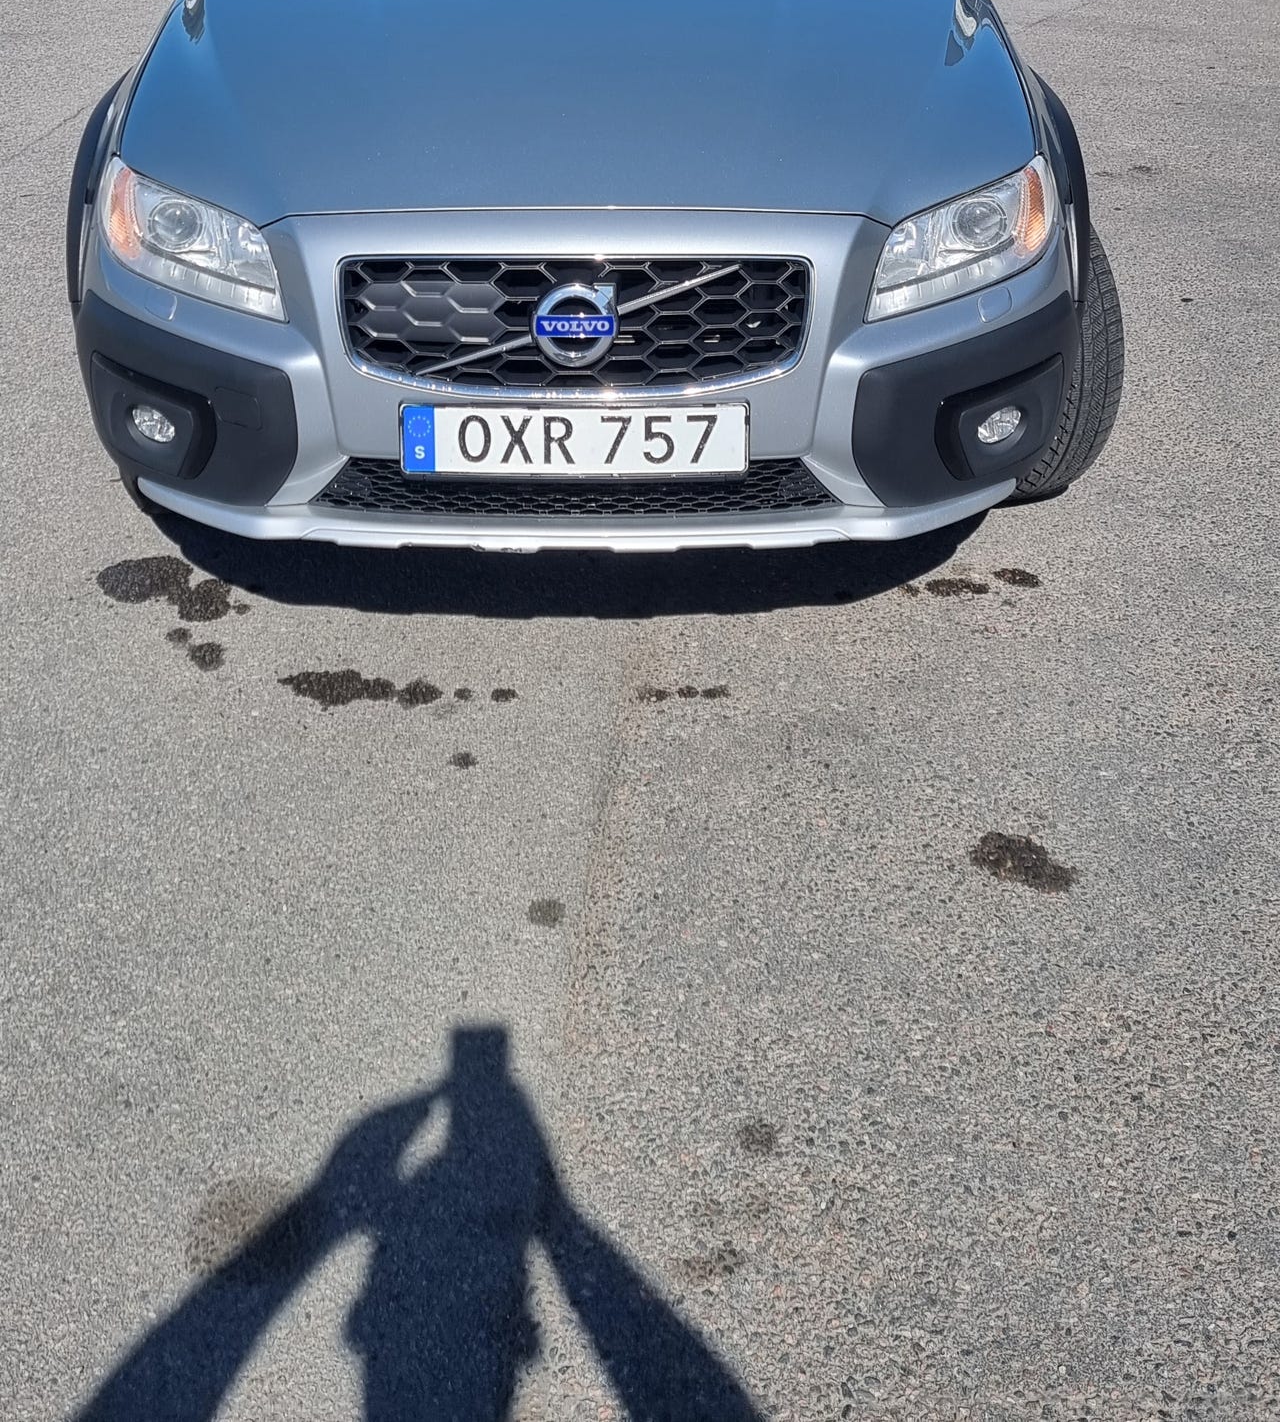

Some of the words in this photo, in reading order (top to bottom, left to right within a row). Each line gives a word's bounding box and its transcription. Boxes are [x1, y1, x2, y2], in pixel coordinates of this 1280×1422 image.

[540, 320, 610, 332] VOLVO
[457, 414, 576, 465] OXR
[600, 415, 718, 464] 757
[414, 445, 426, 460] S
